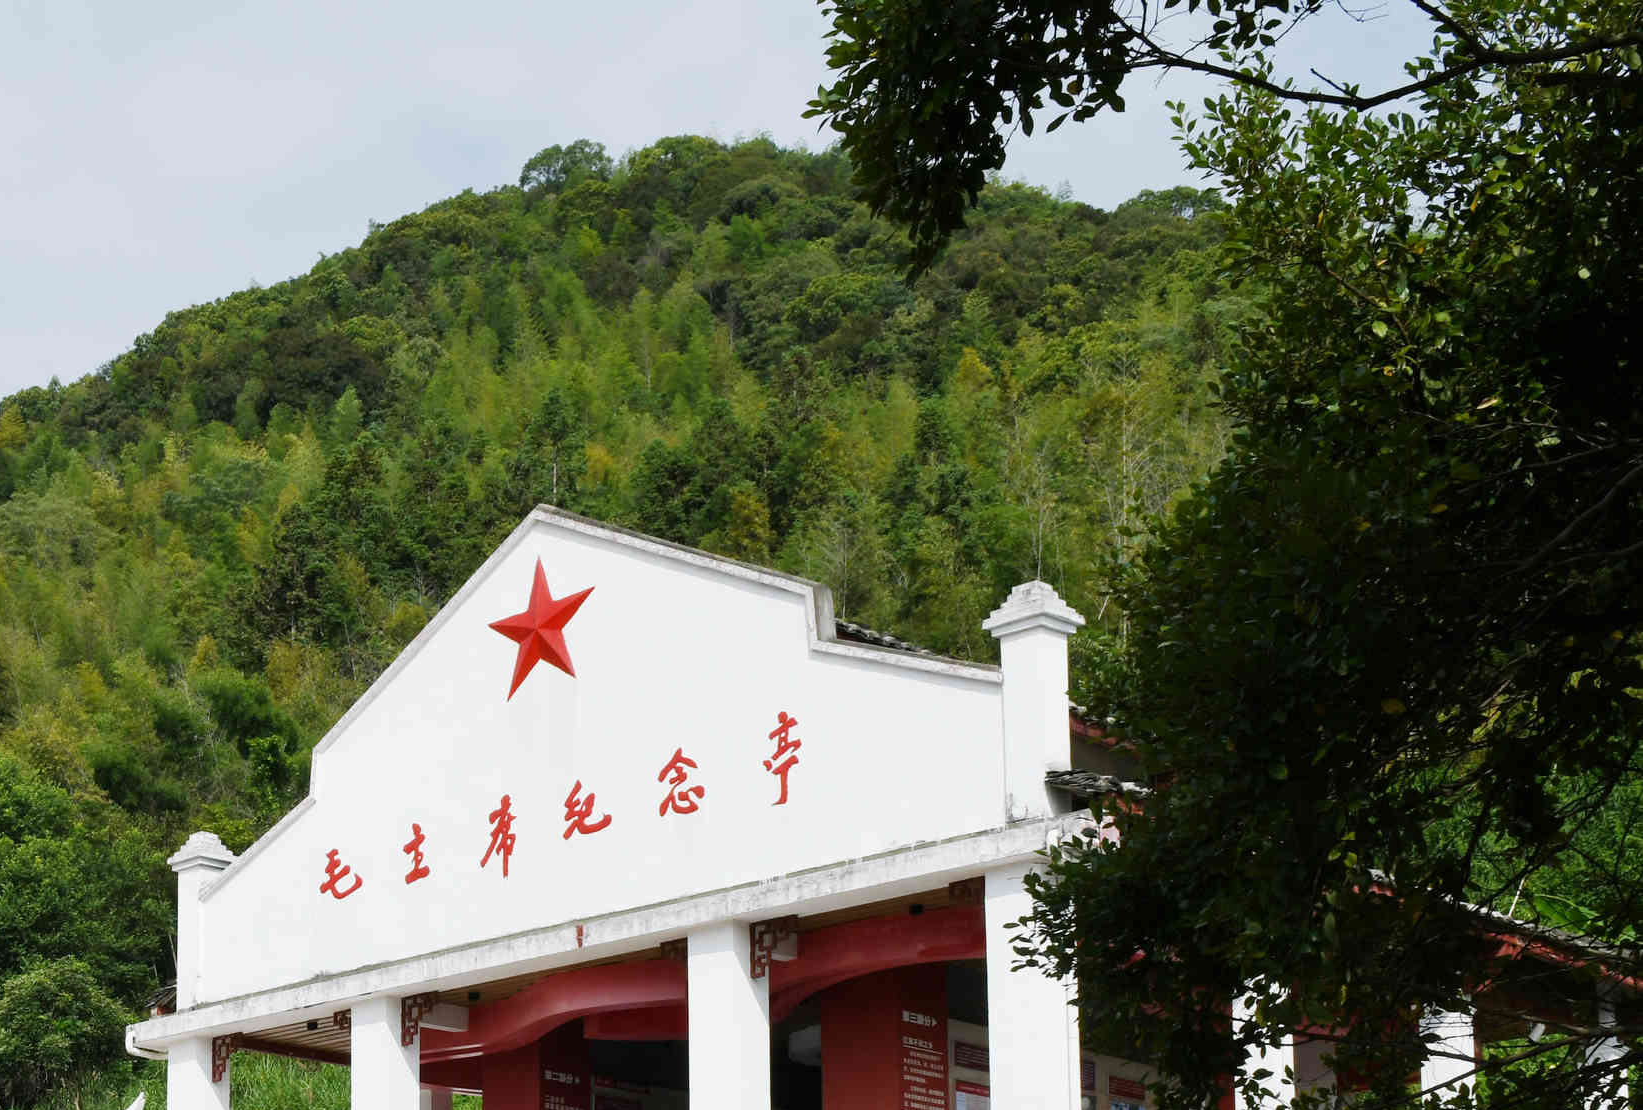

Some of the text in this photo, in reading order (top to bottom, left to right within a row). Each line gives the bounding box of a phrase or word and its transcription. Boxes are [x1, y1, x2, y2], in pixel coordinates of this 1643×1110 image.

[319, 711, 802, 899] 毛主席纪念亭
